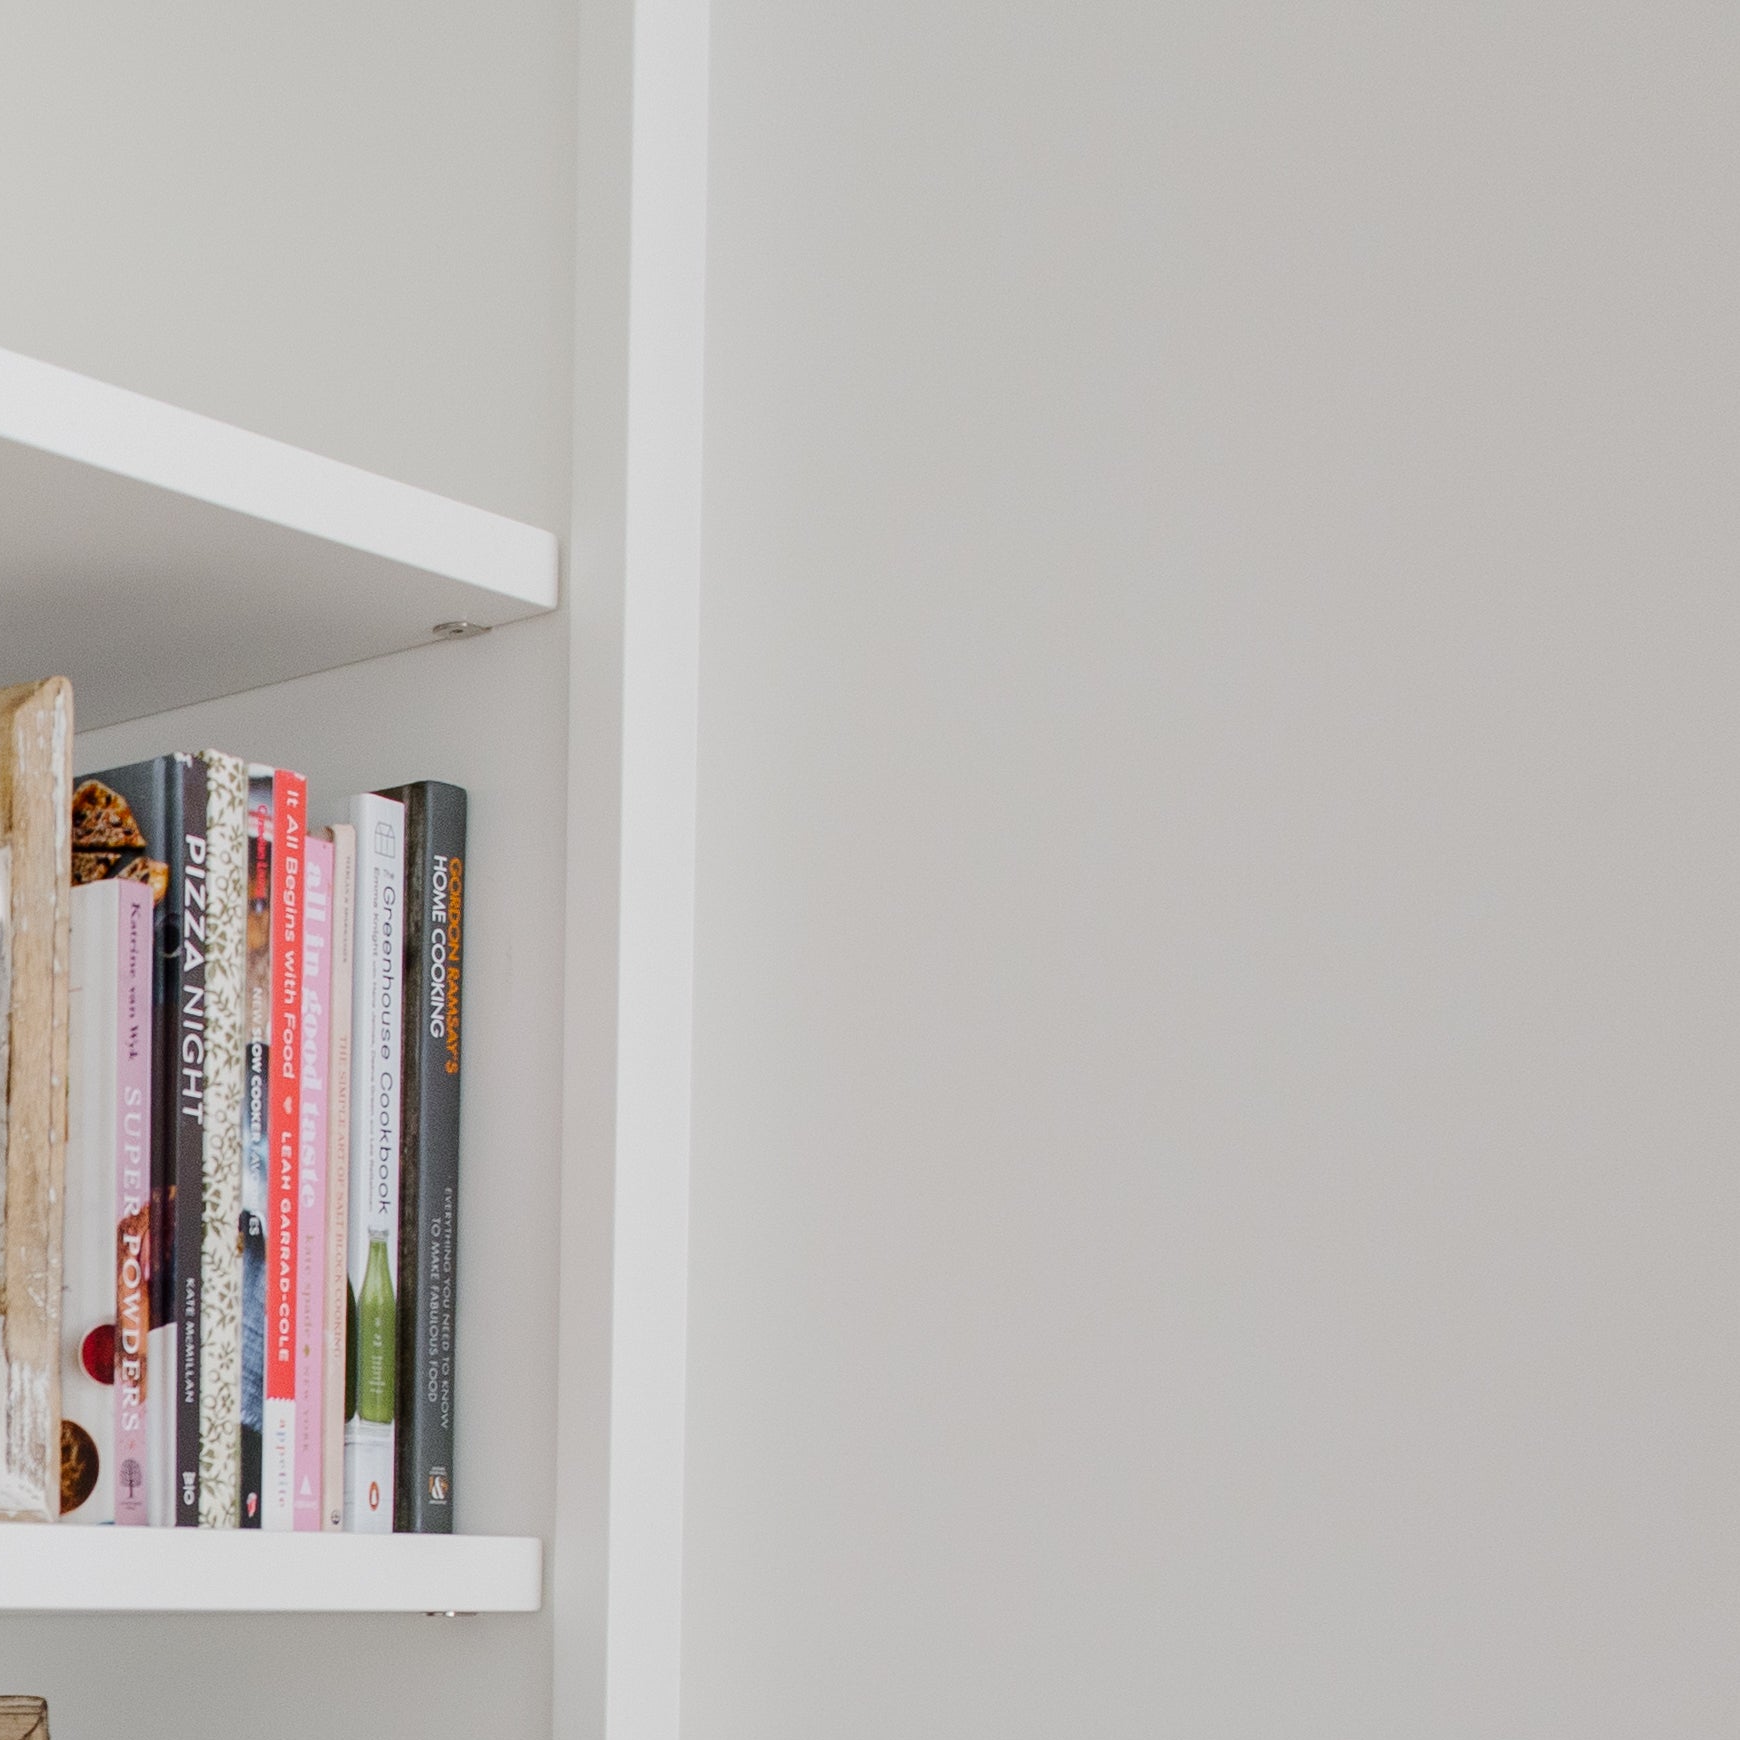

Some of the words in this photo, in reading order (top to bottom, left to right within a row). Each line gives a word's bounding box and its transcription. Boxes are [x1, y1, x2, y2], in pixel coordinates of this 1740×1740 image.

[285, 789, 299, 806] It
[285, 814, 299, 848] All
[184, 835, 206, 973] PIZZA
[283, 856, 298, 941] Begins
[307, 861, 328, 921] all
[432, 855, 448, 924] HOME
[448, 858, 462, 961] GORDON
[129, 902, 142, 979] Katrine
[305, 935, 326, 976] in
[129, 987, 138, 1019] van
[283, 950, 298, 1004] with
[381, 886, 396, 1060] Greenhouse
[429, 928, 446, 1039] COOKING
[252, 987, 263, 1023] NEW
[445, 968, 460, 1073] RAMSAY'S
[126, 1024, 140, 1061] Wyk
[182, 984, 204, 1124] NIGHT
[251, 1027, 263, 1073] SLOW
[282, 1012, 296, 1079] Food
[302, 987, 324, 1091] good
[250, 1075, 263, 1143] COOKER
[338, 1071, 348, 1129] SIMPLE
[124, 1087, 142, 1216] SUPER
[280, 1131, 292, 1191] LEAH
[302, 1101, 321, 1208] taste
[337, 1134, 347, 1161] ART
[378, 1072, 394, 1214] Cookbook
[336, 1191, 346, 1228] SALT
[431, 1216, 442, 1237] TO
[442, 1187, 453, 1274] EVERYTHING
[279, 1197, 292, 1363] GARRAD-COLE
[335, 1233, 345, 1283] BLOCK
[430, 1242, 441, 1280] MAKE
[185, 1277, 196, 1317] KATE
[334, 1288, 344, 1358] COOKING
[428, 1284, 439, 1357] FABULOUS
[442, 1278, 451, 1310] YOU
[122, 1234, 140, 1431] POWDERS
[184, 1320, 196, 1403] McMILLAN
[441, 1313, 451, 1352] NEED
[427, 1360, 439, 1403] FOOD
[441, 1355, 450, 1374] TO
[439, 1377, 450, 1430] KNOW
[275, 1418, 288, 1508] appetite
